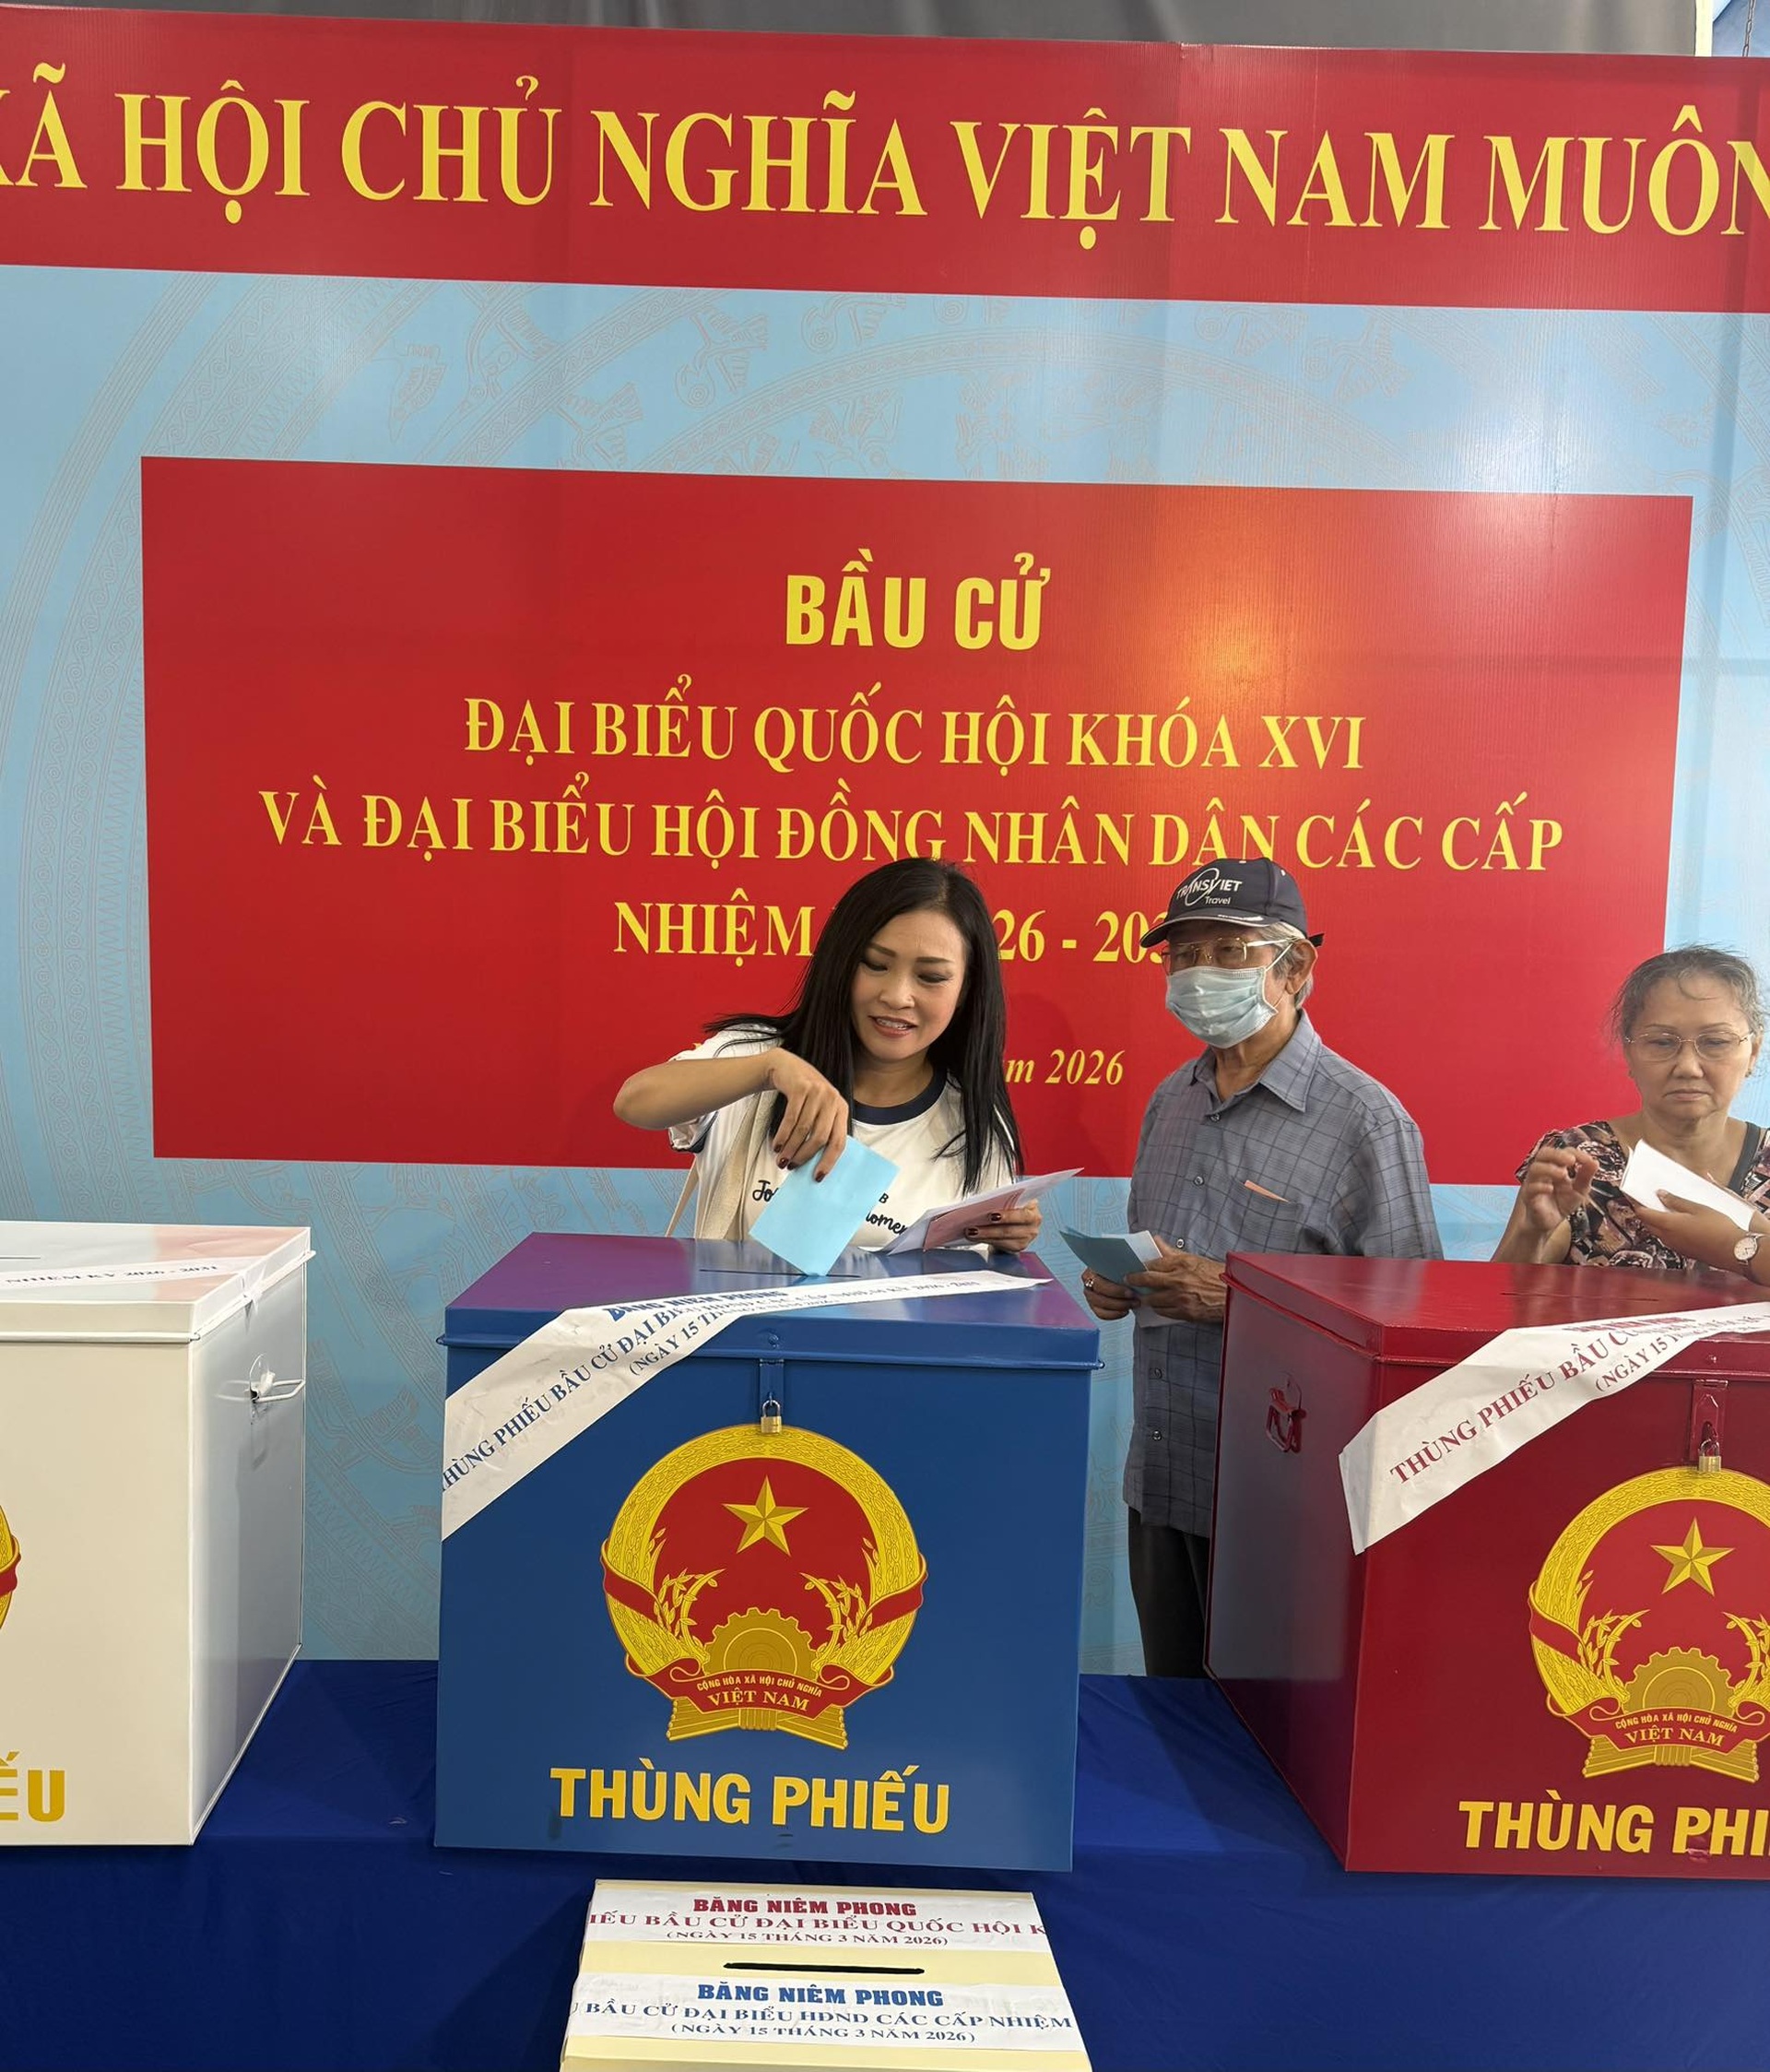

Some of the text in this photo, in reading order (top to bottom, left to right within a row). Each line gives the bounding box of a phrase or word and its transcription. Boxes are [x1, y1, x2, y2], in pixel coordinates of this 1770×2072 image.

[0, 63, 1770, 250] Ã HỘI CHỦ NGHĨA VIỆT NAM MUÔN
[784, 548, 1052, 651] BẦU CỬ
[465, 675, 1363, 777] ĐẠI BIỂU QUỐC HỘI KHÓA XVI
[259, 772, 1564, 871] VÀ ĐẠI BIỂU HỘI ĐỒNG NHÂN DÂN CÁC CẤP
[1205, 895, 1231, 906] Travel
[613, 888, 1168, 967] NHIỆM 26 - 20
[1044, 1049, 1124, 1084] 2026
[630, 1321, 699, 1376] (NGÀY 15
[1595, 1337, 1669, 1392] (NGÀY 15
[442, 1439, 495, 1491] HÙNG
[493, 1397, 553, 1447] PHIẾU
[550, 1369, 593, 1403] BẦU
[591, 1344, 619, 1369] CỬ
[617, 1320, 655, 1354] ĐẠI
[1390, 1420, 1476, 1485] THÙNG
[1476, 1373, 1555, 1429] PHIẾU
[1557, 1343, 1610, 1381] BẦU
[697, 1678, 721, 1692] CỘNG
[759, 1675, 774, 1687] HỘI
[707, 1687, 809, 1711] VIỆT NAM
[1615, 1716, 1639, 1730] CỘNG
[1677, 1712, 1692, 1723] HỘI
[1624, 1724, 1725, 1747] VIỆT NAM
[549, 1758, 950, 1834] THÙNG PHIẾU
[1457, 1789, 1770, 1856] THÙNG PHI
[645, 1912, 702, 1927] BẦU
[709, 1913, 749, 1928] CỬ
[756, 1917, 806, 1931] ĐẠI
[814, 1915, 879, 1931] BIỂU
[886, 1918, 964, 1934] QUỐC
[973, 1921, 1021, 1936] HỘI
[693, 1896, 917, 1917] BĂNG NIÊM PHONG
[667, 1929, 949, 1947] (NGÀY 15 THÁNG 3 NĂM 2026)
[698, 1982, 944, 2007] BĂNG NIÊM PHONG
[585, 1998, 636, 2015] BẦU
[643, 2003, 678, 2017] CỬ
[684, 2007, 727, 2022] ĐẠI
[736, 2006, 793, 2022] BIỂU
[800, 2010, 869, 2025] HĐND
[876, 2012, 927, 2027] CÁC
[934, 2012, 983, 2028] CẤP
[988, 2014, 1072, 2030] NHIỆM
[671, 2023, 975, 2042] (NGÀY 15 THÁNG 3 NĂM 2026)
